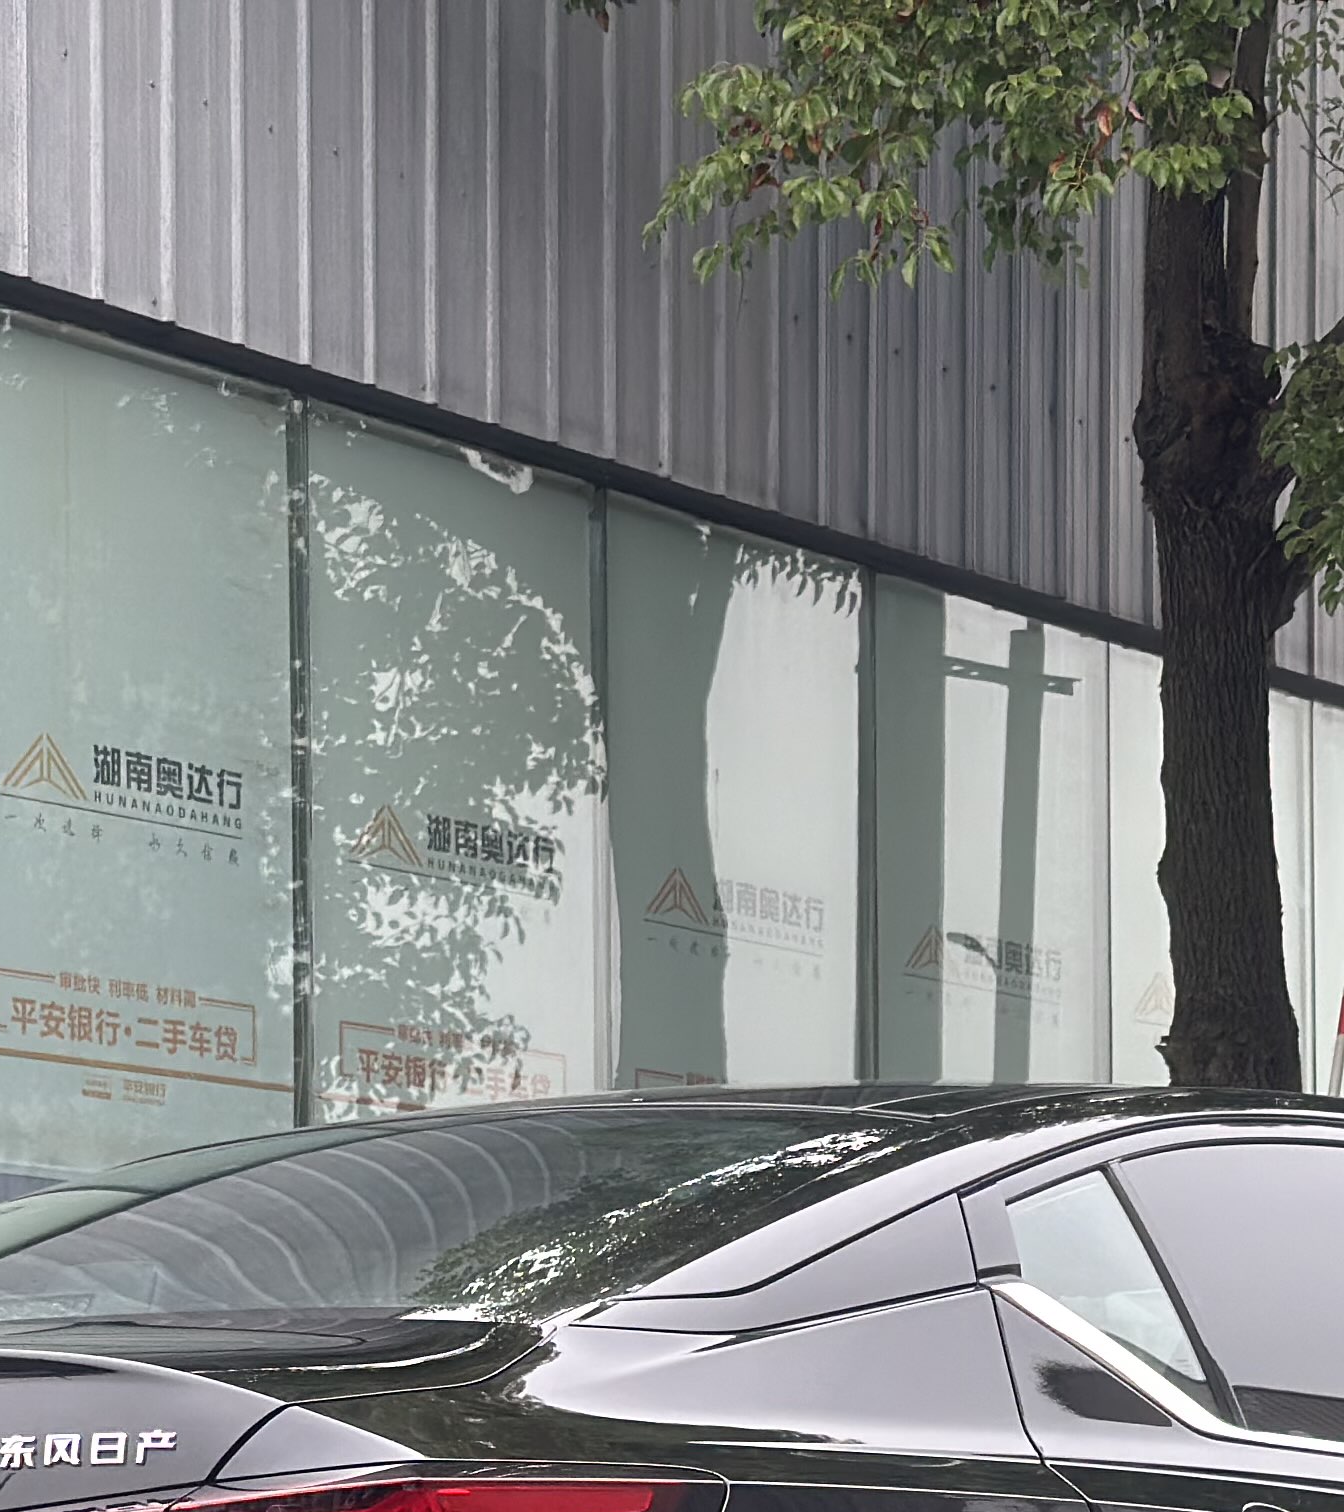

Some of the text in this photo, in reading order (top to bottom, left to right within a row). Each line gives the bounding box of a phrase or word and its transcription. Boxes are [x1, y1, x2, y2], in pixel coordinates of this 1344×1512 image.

[92, 744, 243, 811] 湖南奥达行
[94, 790, 243, 830] HUNANAODAHANG
[426, 813, 556, 873] 湖南奥达行
[10, 996, 239, 1063] 平安银行·二手车贷
[0, 1429, 177, 1469] 东风日产
